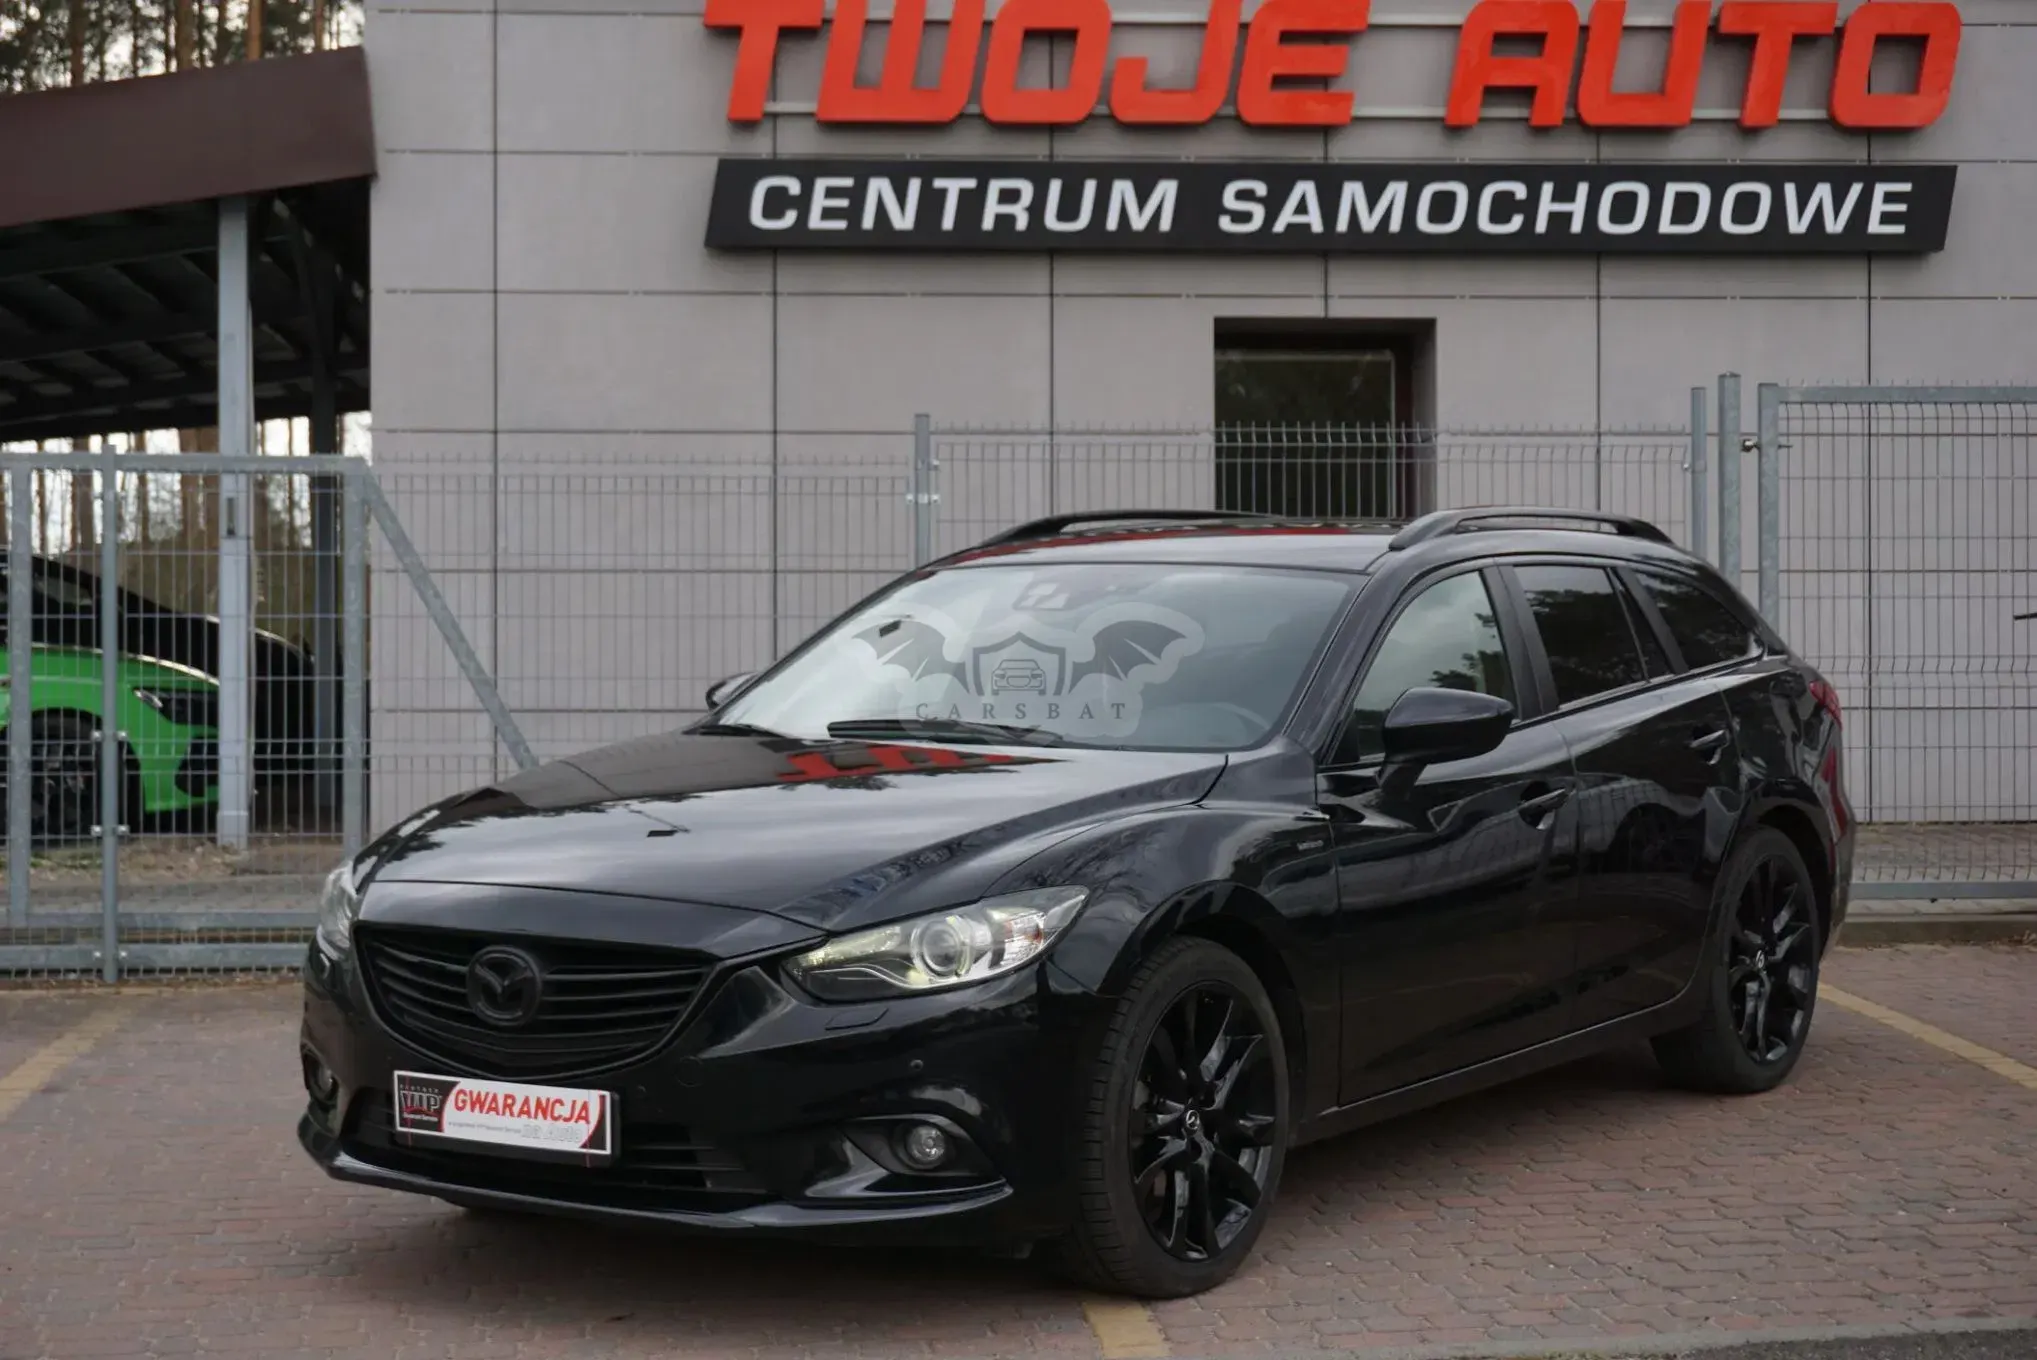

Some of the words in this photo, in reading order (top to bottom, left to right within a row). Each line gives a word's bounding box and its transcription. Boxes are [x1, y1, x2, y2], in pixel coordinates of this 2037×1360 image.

[704, 0, 1371, 124] TWOJE
[1445, 0, 1962, 126] AUTO
[750, 176, 1178, 231] CENTRUM
[1219, 180, 1912, 234] SAMOCHODOWE
[454, 1090, 589, 1122] GWARANCJA
